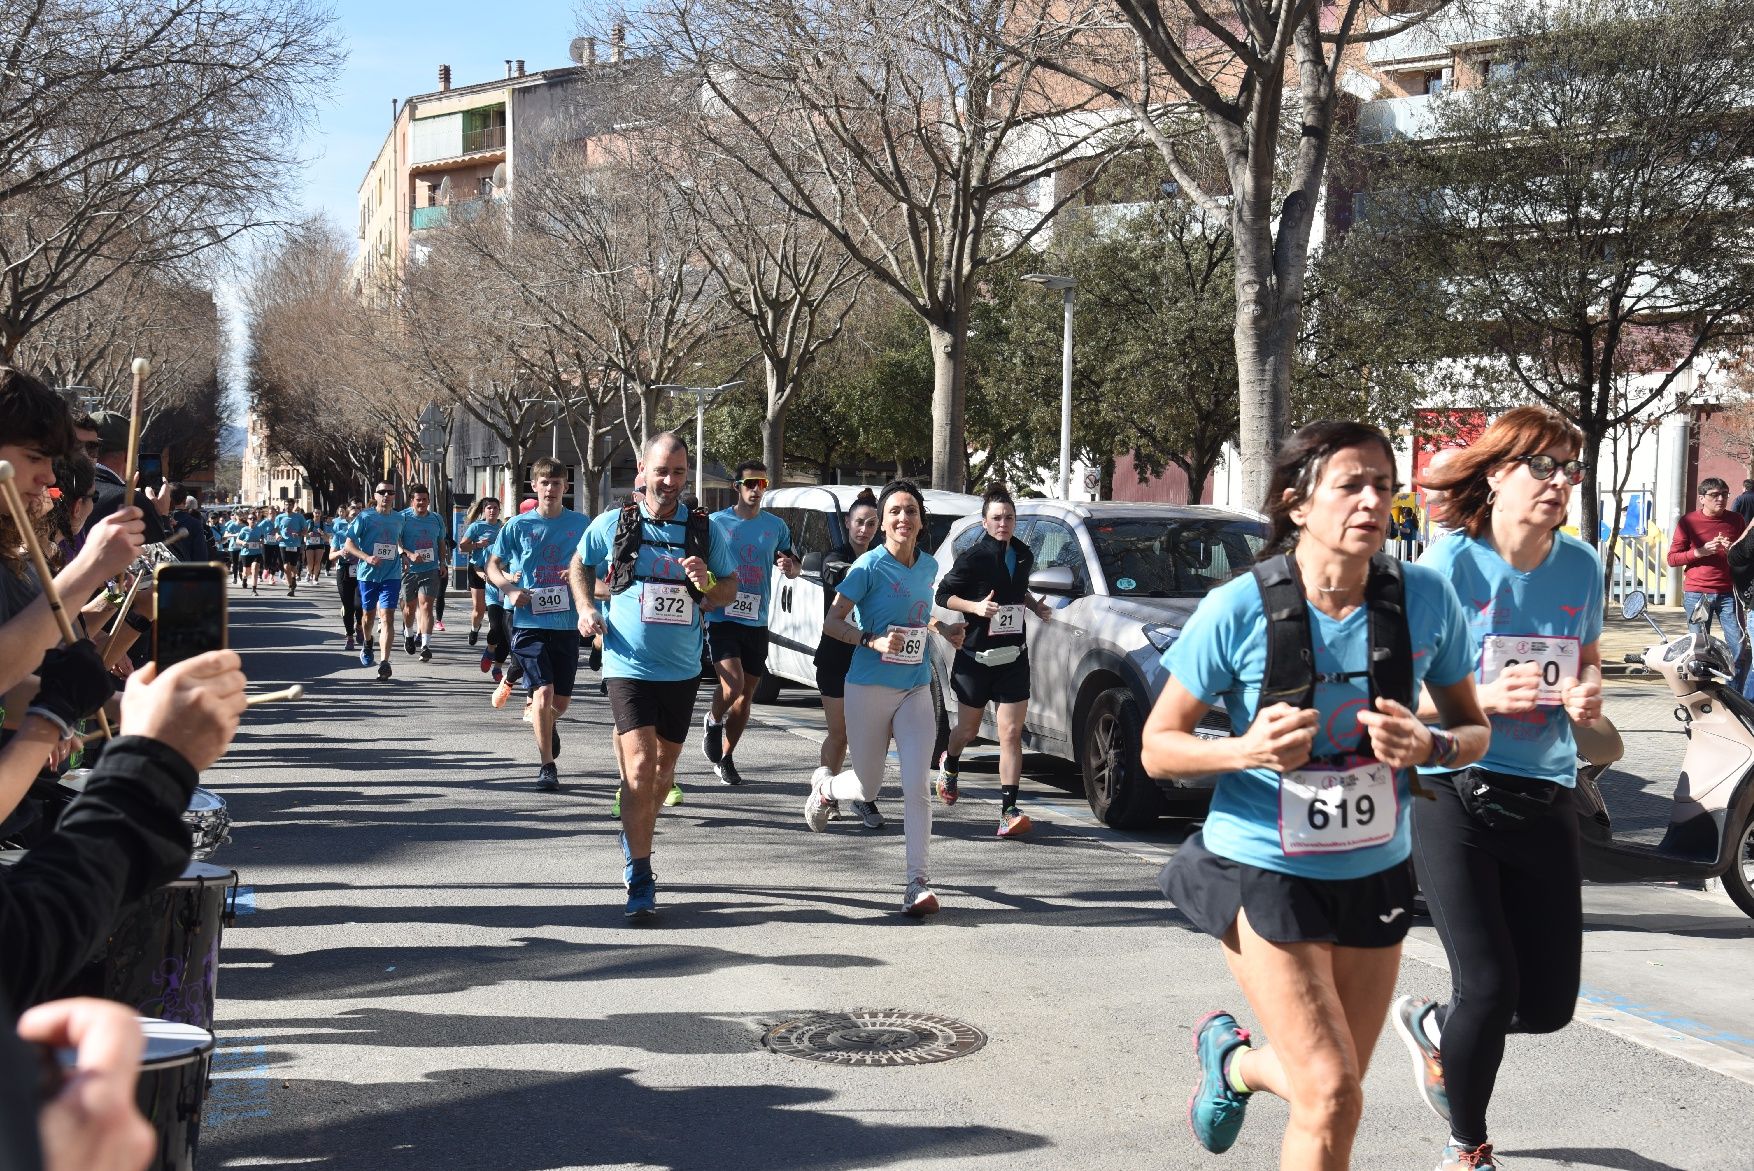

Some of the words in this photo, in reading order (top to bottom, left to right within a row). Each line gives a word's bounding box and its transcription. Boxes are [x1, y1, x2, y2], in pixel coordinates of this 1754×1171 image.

[539, 595, 561, 606] 340
[655, 597, 684, 613] 372
[733, 600, 753, 612] 284
[1000, 614, 1013, 626] 21
[1308, 795, 1375, 830] 619
